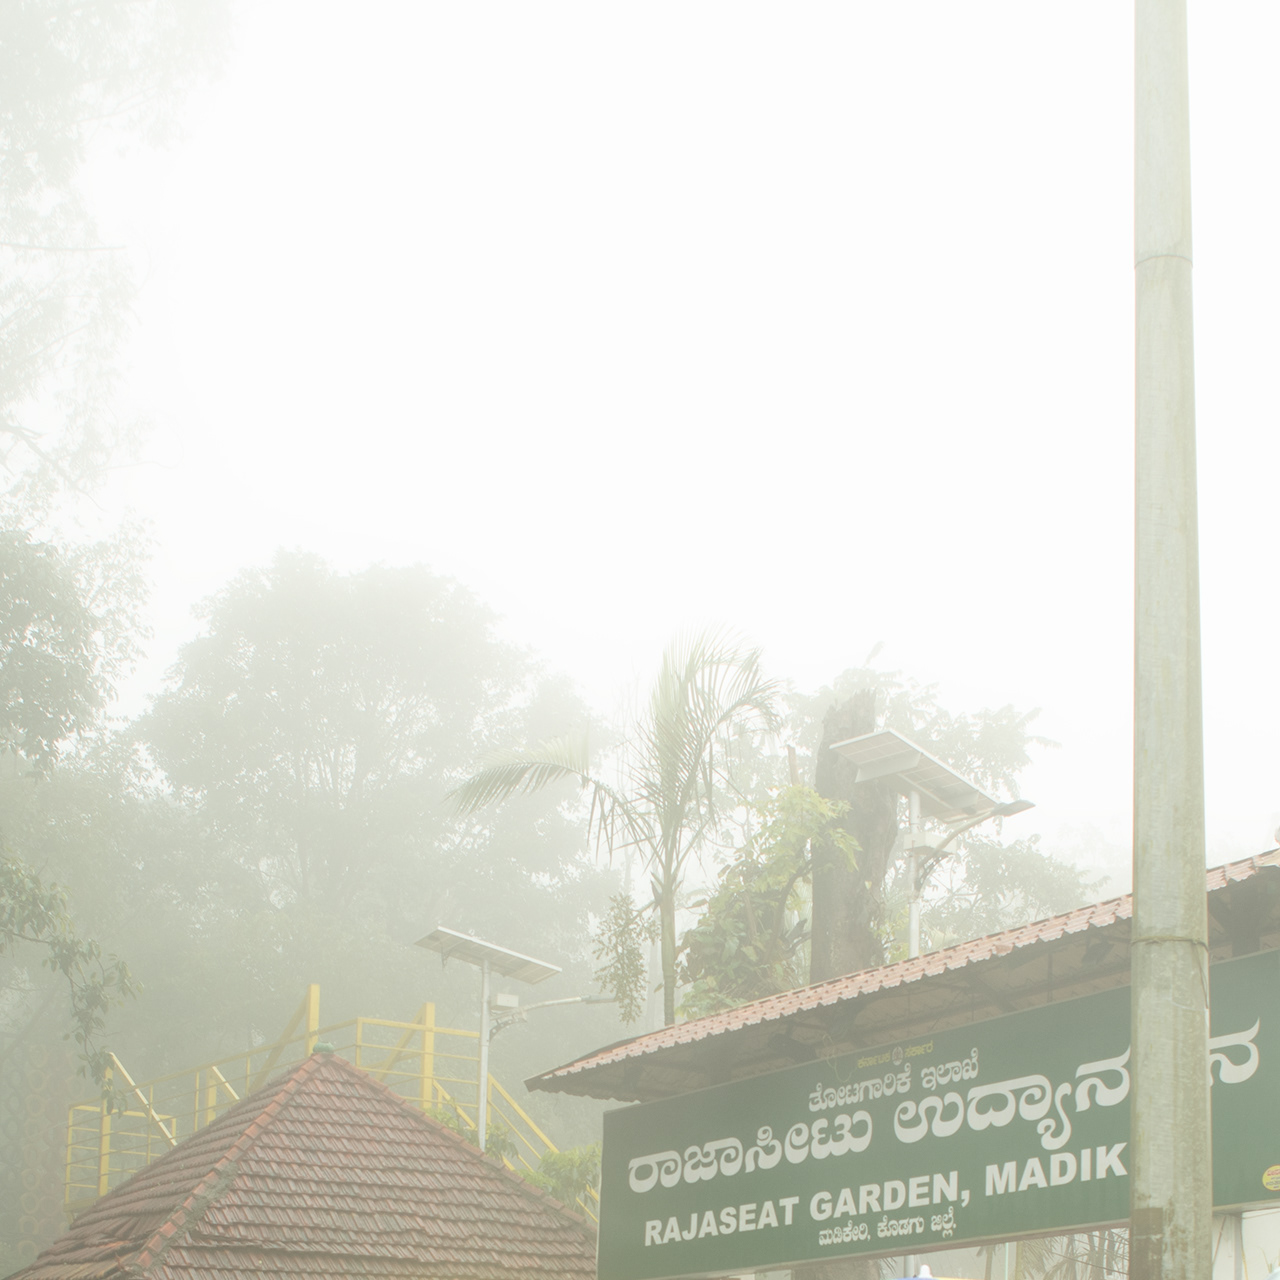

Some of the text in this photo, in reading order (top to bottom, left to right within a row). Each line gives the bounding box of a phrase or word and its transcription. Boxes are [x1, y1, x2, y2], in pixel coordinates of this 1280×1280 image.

[628, 1016, 1260, 1193] ರಾಜಾಸೀಟು ಉದ್ಯಾನನ
[808, 1047, 979, 1112] ತೋಟಗಾರಿಕೆ ಇಲಾಖೆ
[645, 1142, 1128, 1246] RAJASEAT GARDEN, MADIK
[877, 1215, 924, 1238] ಕೊಡಗು
